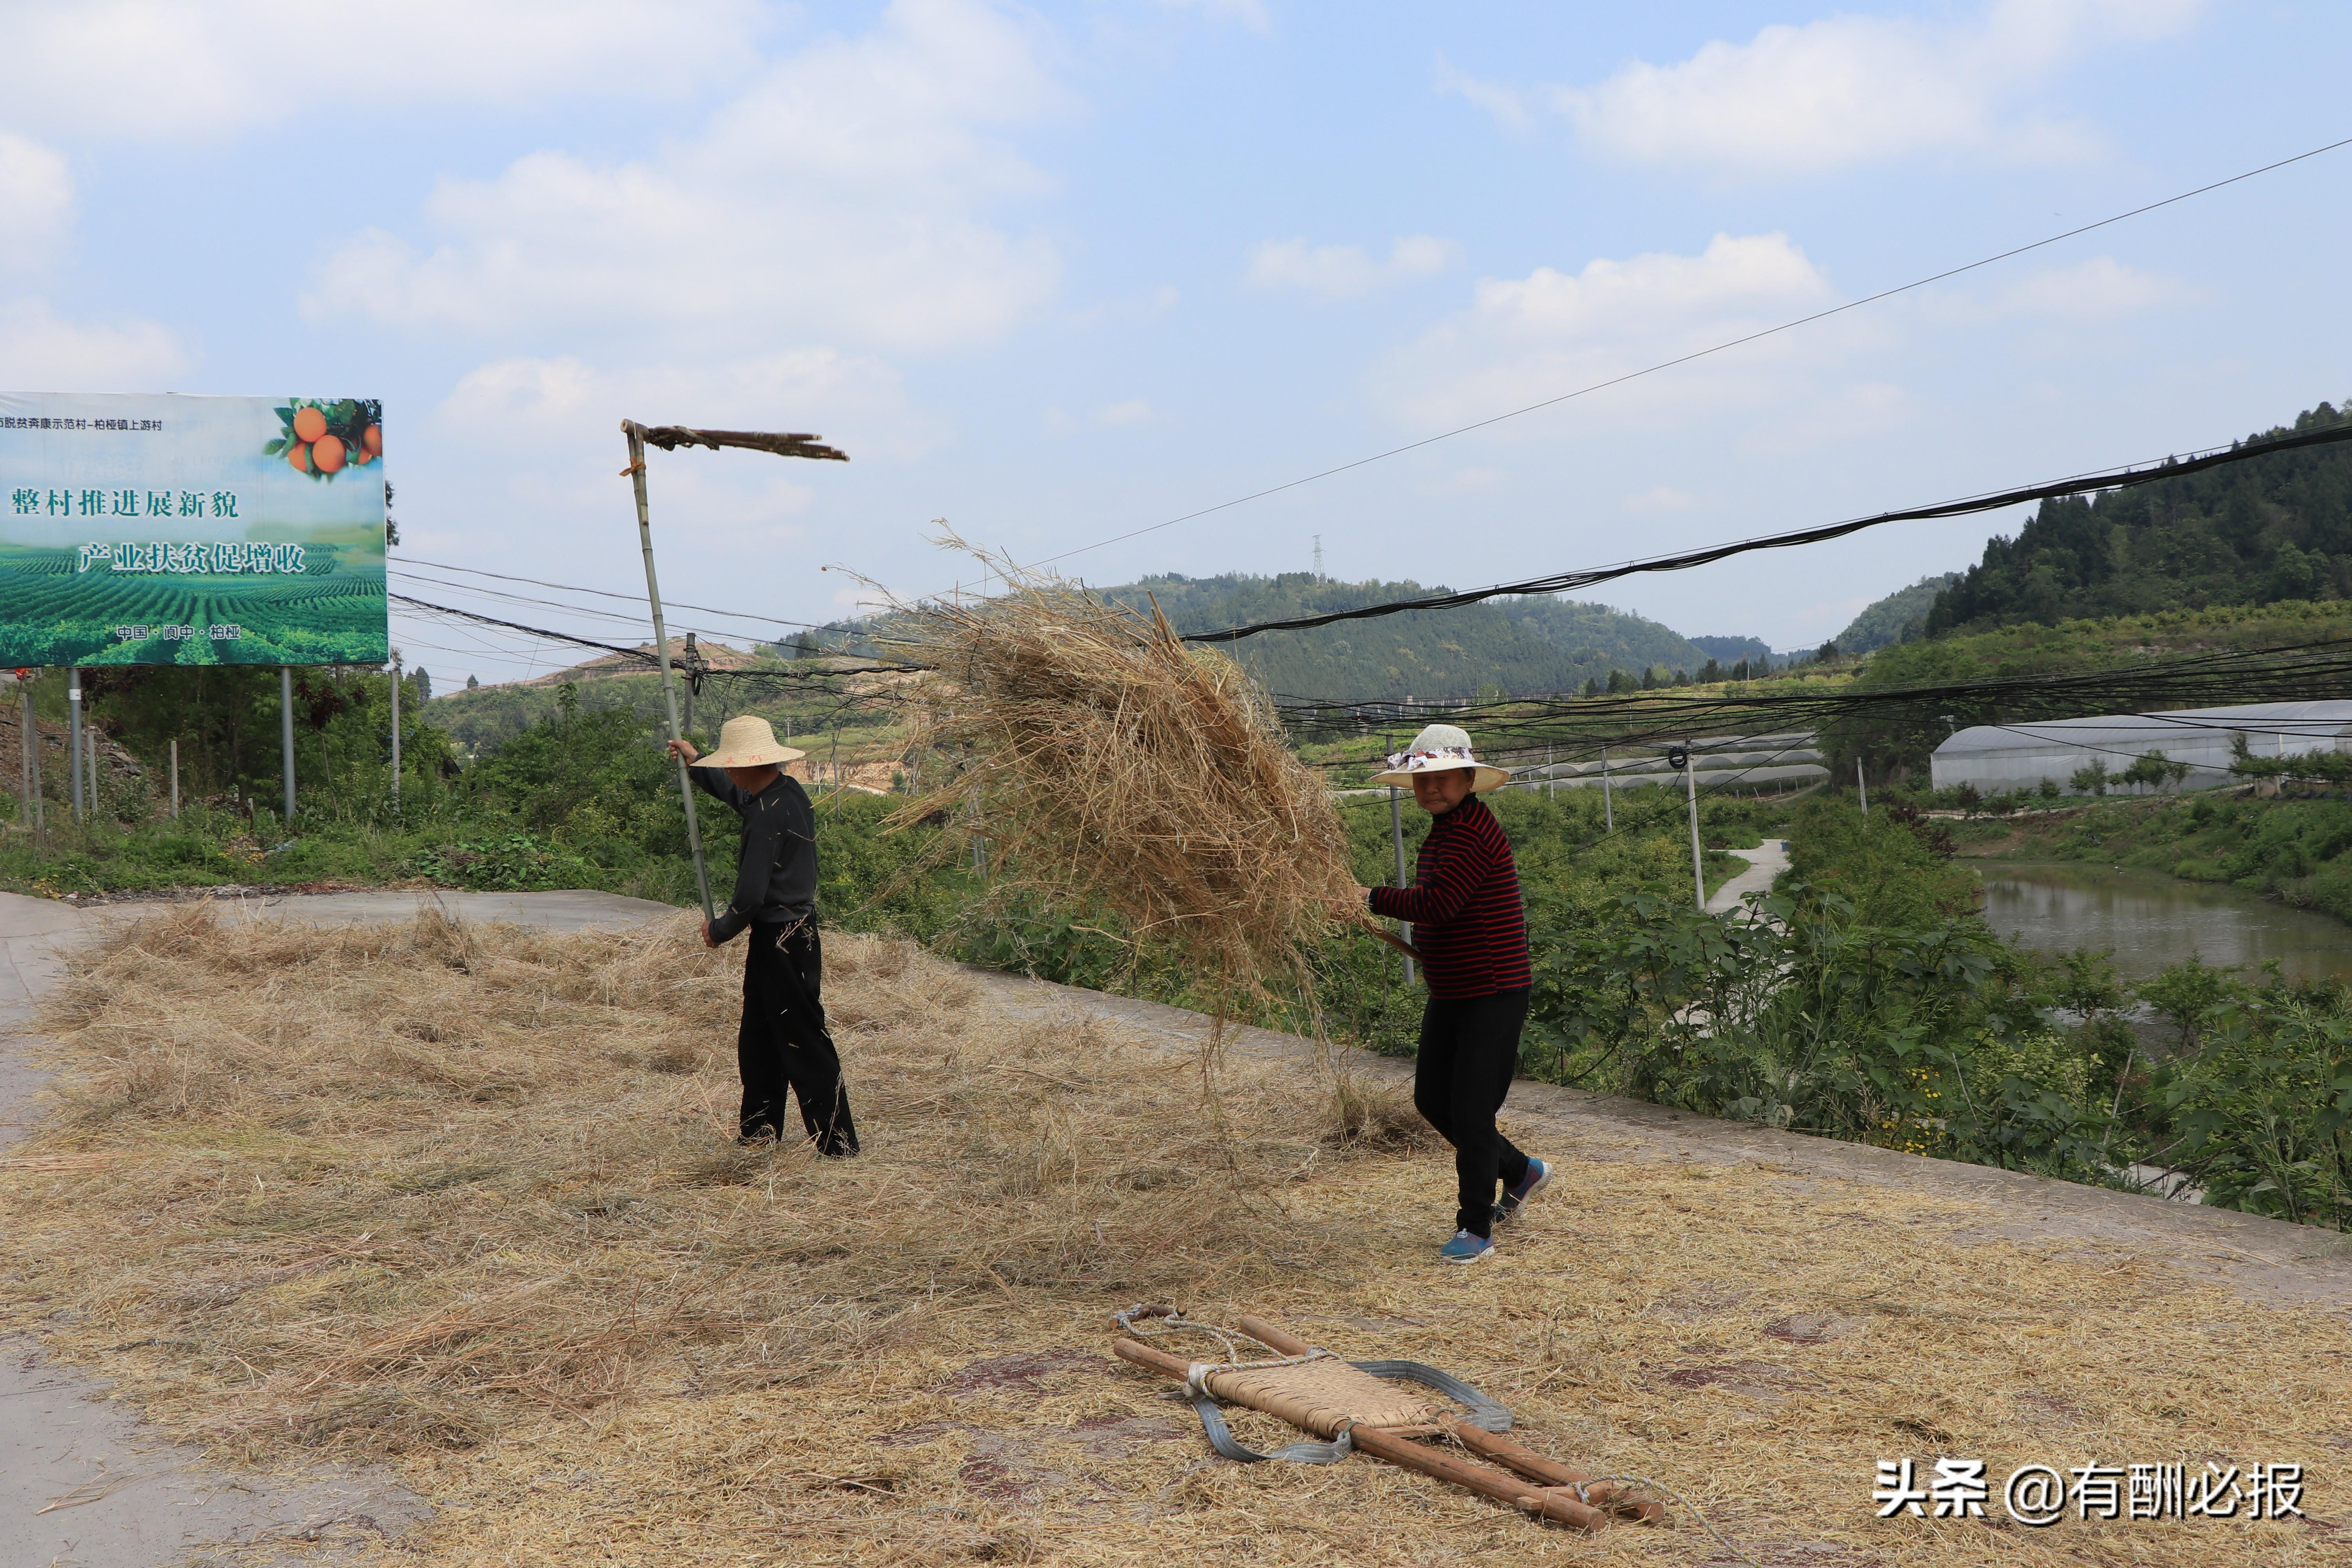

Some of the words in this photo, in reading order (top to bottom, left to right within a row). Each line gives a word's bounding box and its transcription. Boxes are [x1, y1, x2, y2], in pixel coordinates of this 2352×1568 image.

[10, 488, 239, 518] 整村推进展新貌
[79, 543, 306, 573] 产业扶贫促增收
